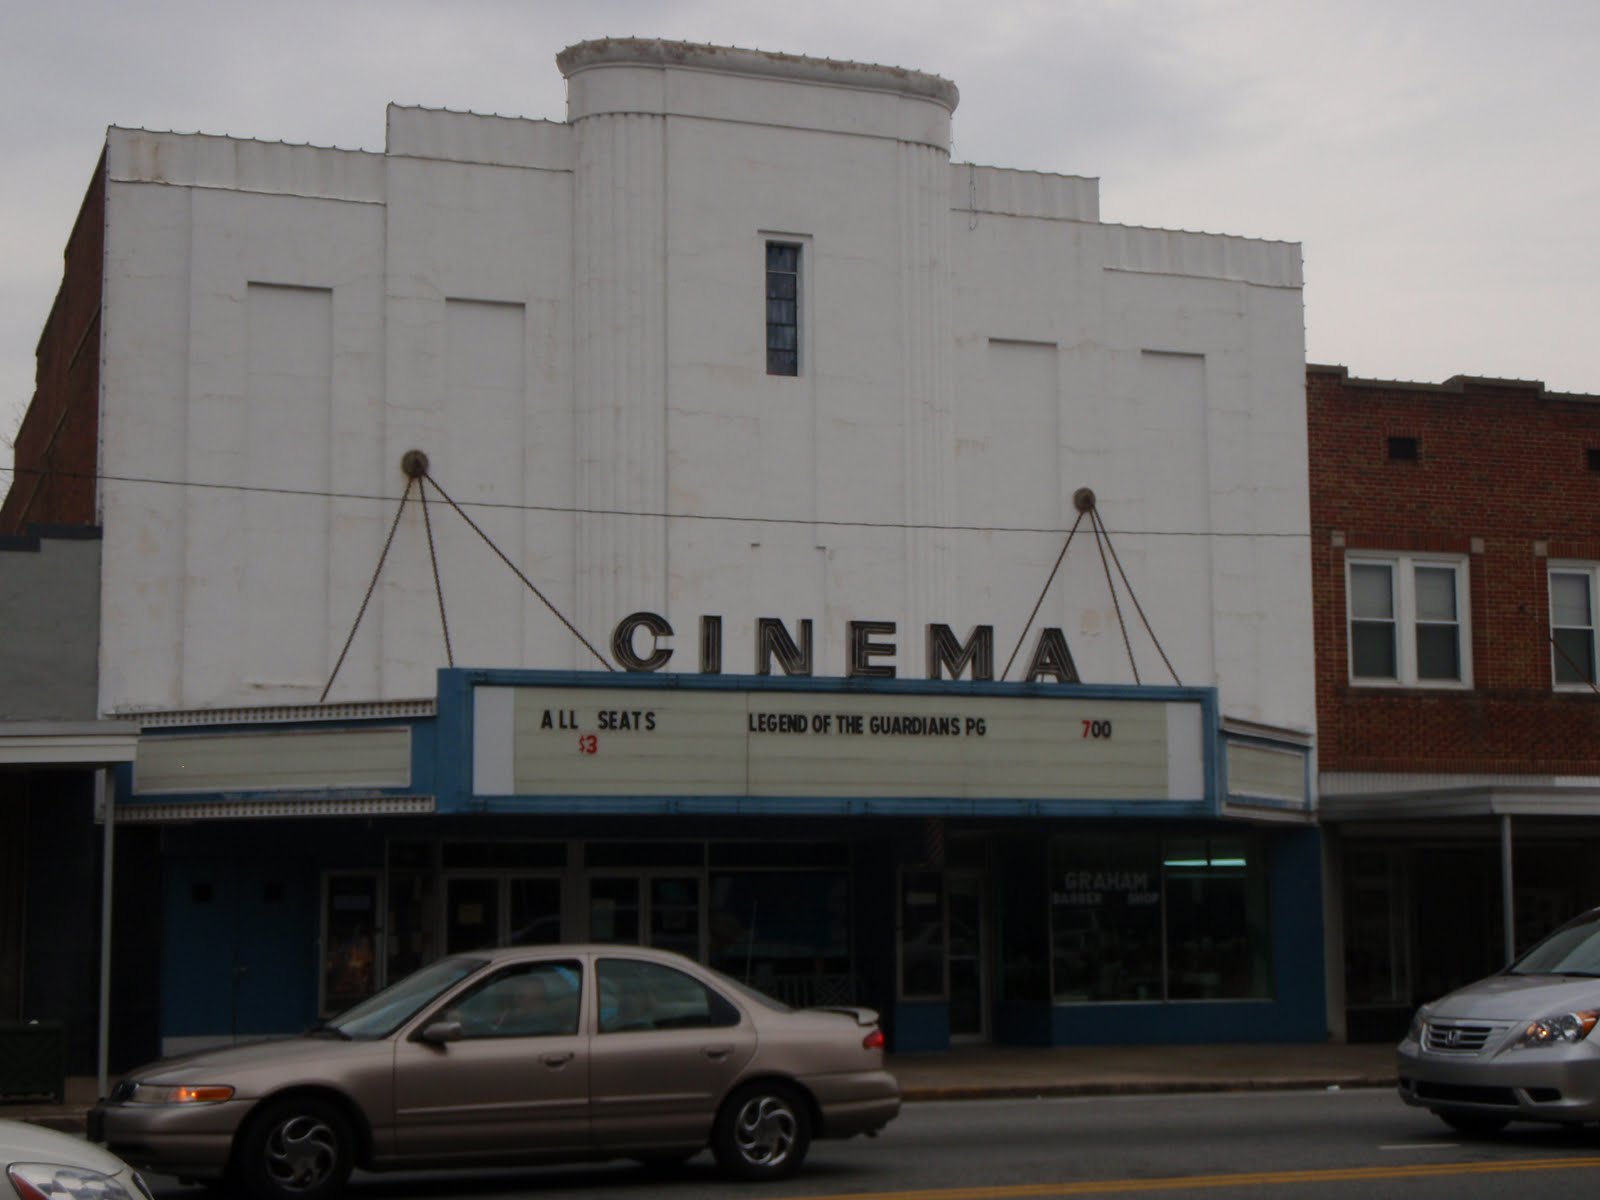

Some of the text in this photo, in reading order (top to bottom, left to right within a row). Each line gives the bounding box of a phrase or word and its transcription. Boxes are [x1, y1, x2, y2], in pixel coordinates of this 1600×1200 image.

[611, 611, 1079, 683] CINEMA
[541, 709, 656, 731] ALL SEATS
[748, 713, 987, 737] LEGEND OF THE GUARDIANS PG
[1081, 719, 1112, 739] 700
[578, 734, 598, 754] $3
[1063, 871, 1149, 891] GRAHAM
